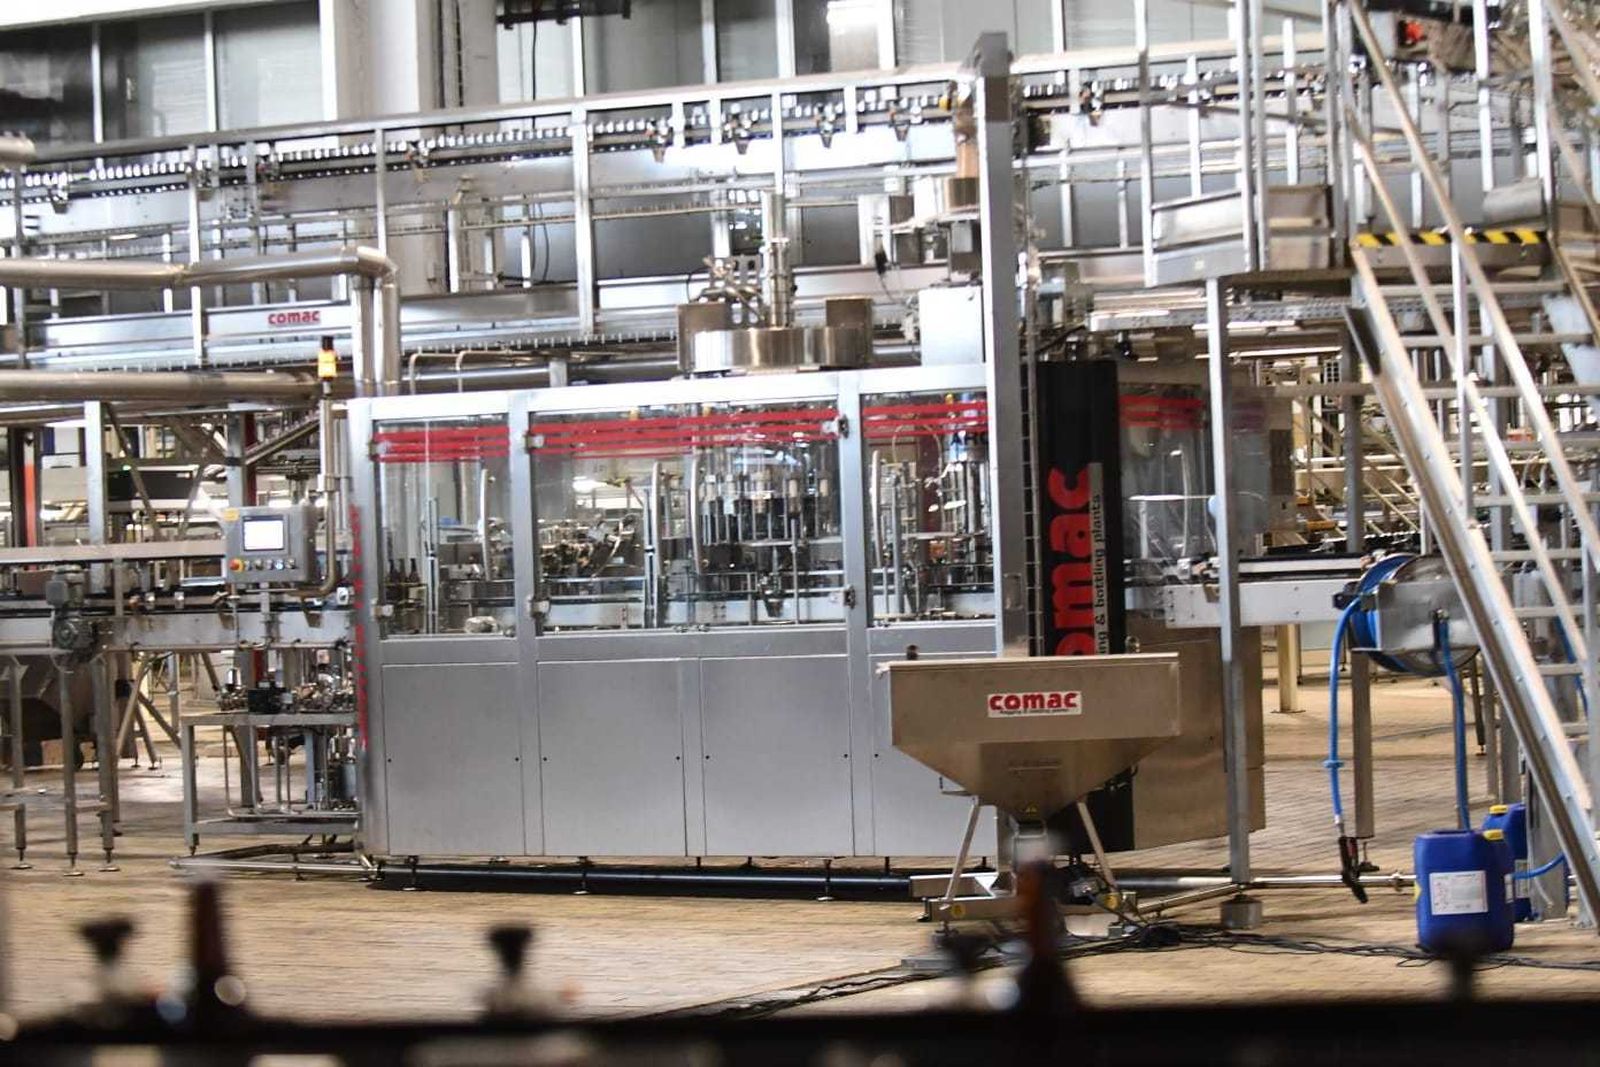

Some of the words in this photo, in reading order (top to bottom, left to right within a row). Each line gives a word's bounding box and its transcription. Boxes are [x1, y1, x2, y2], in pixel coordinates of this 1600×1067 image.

[267, 310, 320, 325] comac
[1091, 494, 1104, 543] plants
[1047, 466, 1096, 656] omac
[1093, 549, 1105, 607] bottling
[1094, 613, 1106, 625] &
[1096, 631, 1109, 655] ing
[989, 692, 1078, 710] comac
